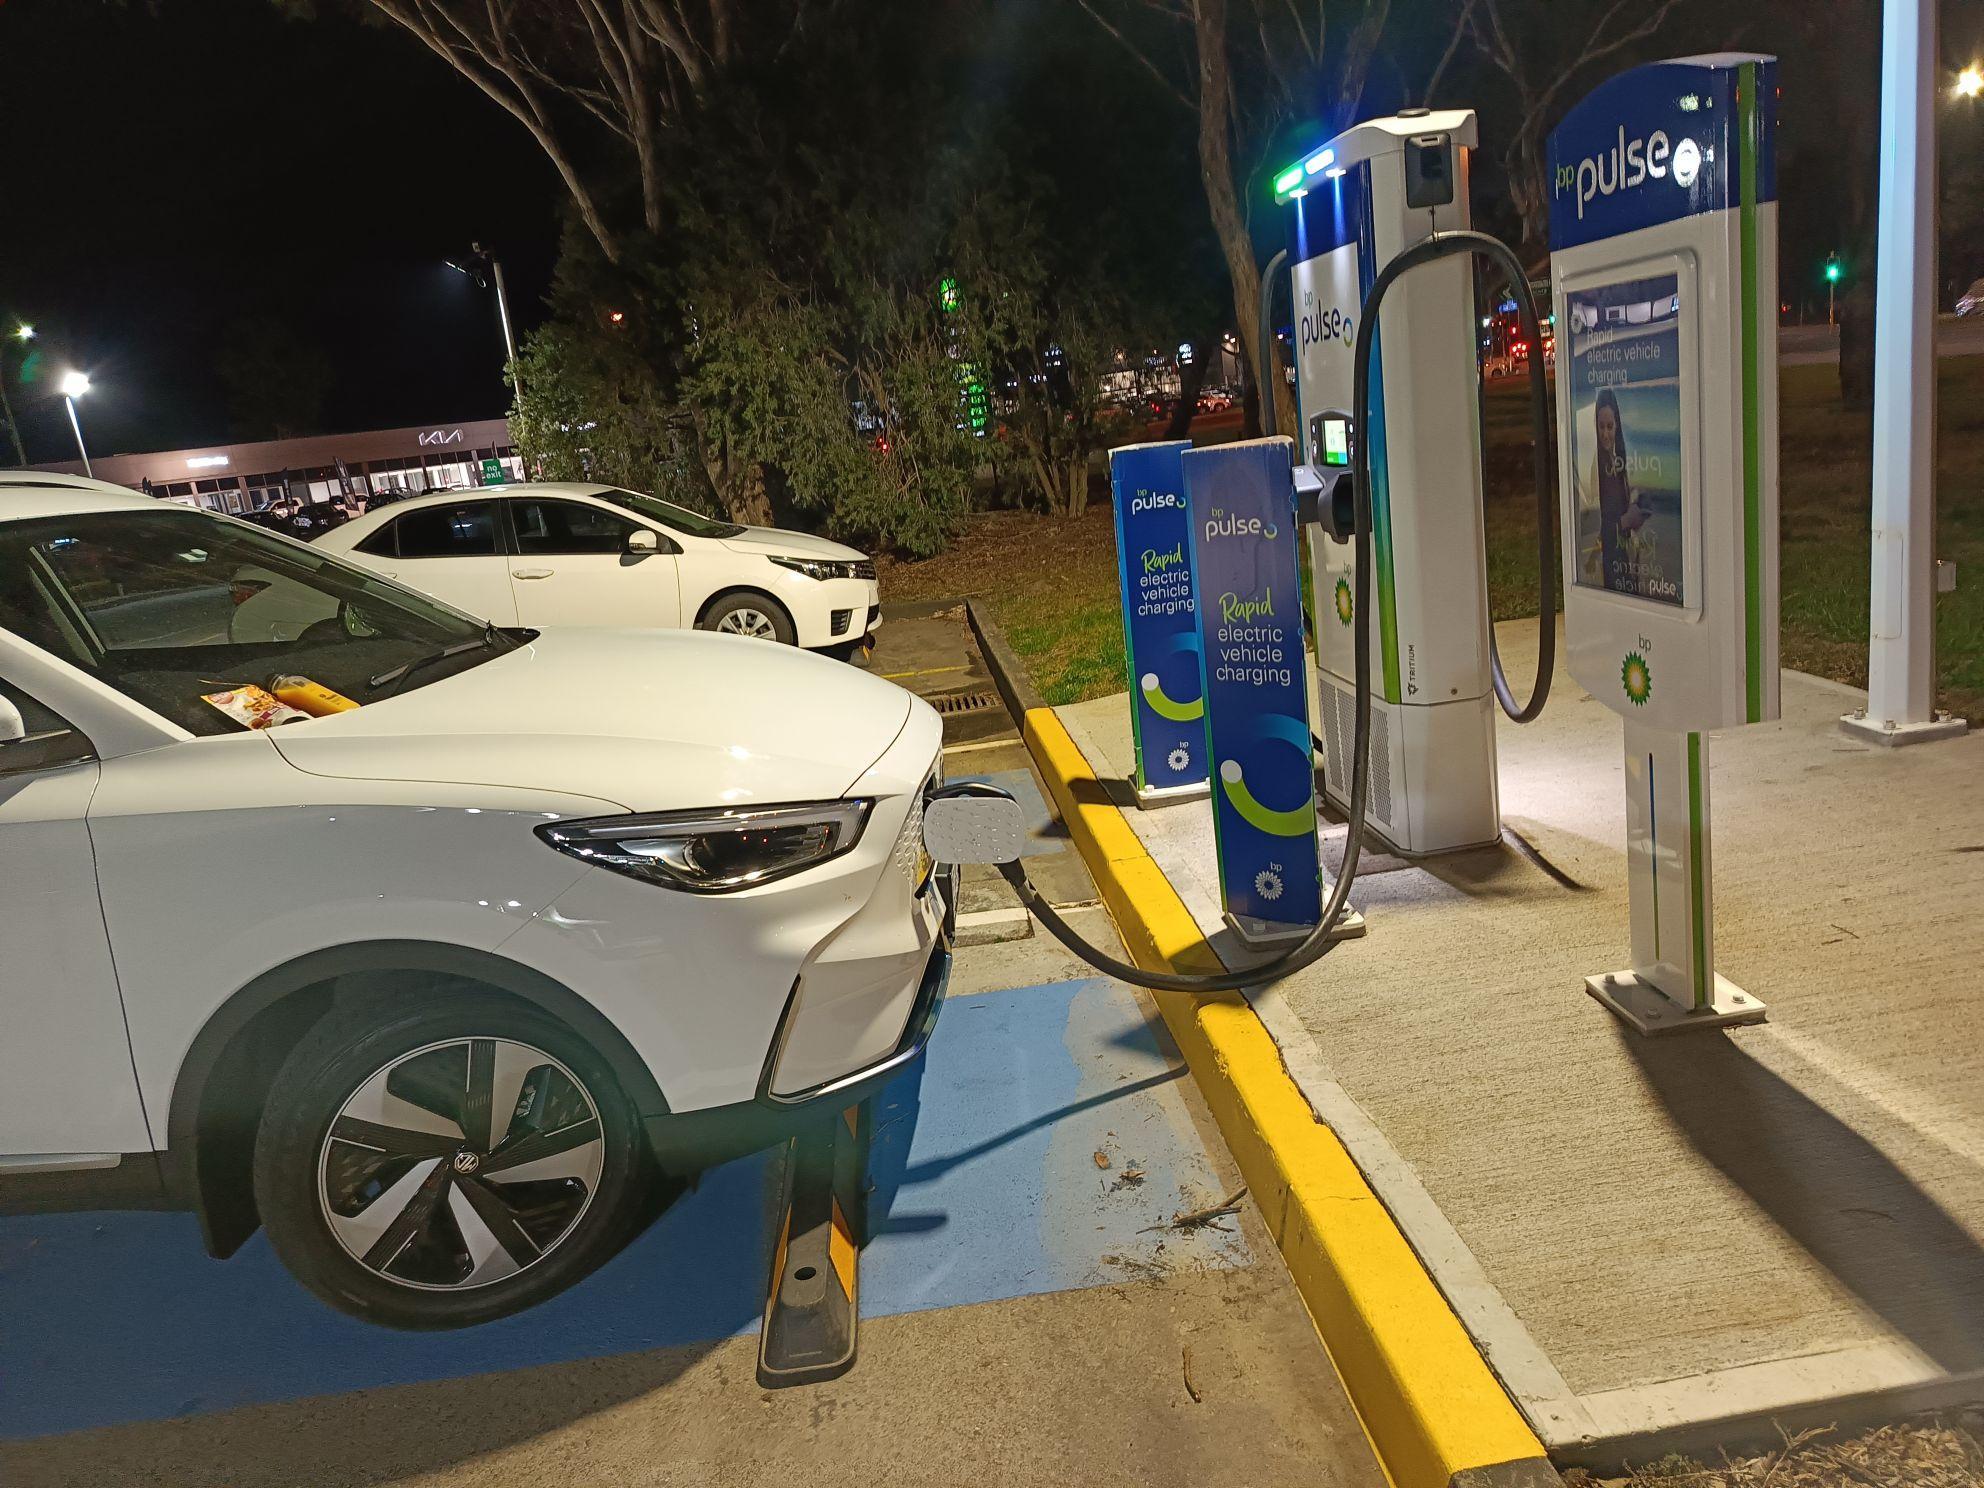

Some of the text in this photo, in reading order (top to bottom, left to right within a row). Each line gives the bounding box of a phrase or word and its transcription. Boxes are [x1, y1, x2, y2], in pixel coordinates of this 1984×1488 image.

[1557, 125, 1670, 220] bp pulse
[1304, 289, 1313, 309] bp
[1301, 299, 1341, 356] pulse
[1587, 325, 1613, 346] Rapid
[1587, 340, 1660, 364] electric vehicle
[1587, 366, 1628, 386] charging
[486, 471, 502, 479] exit
[1137, 488, 1148, 497] bp
[1131, 492, 1176, 515] pulse
[1211, 507, 1224, 520] bp
[1205, 513, 1262, 542] pulse
[1141, 542, 1184, 574] Rapid
[1139, 568, 1190, 587] electric
[1649, 576, 1677, 597] pulse
[1141, 583, 1189, 601] vehicle
[1137, 597, 1195, 616] charging
[1218, 587, 1275, 625] Rapid
[1217, 624, 1283, 643] electric
[1638, 632, 1652, 652] bp
[1219, 643, 1283, 663] vehicle
[1408, 644, 1416, 681] TRITIUM
[1215, 663, 1291, 686] charging
[1270, 861, 1283, 873] bp
